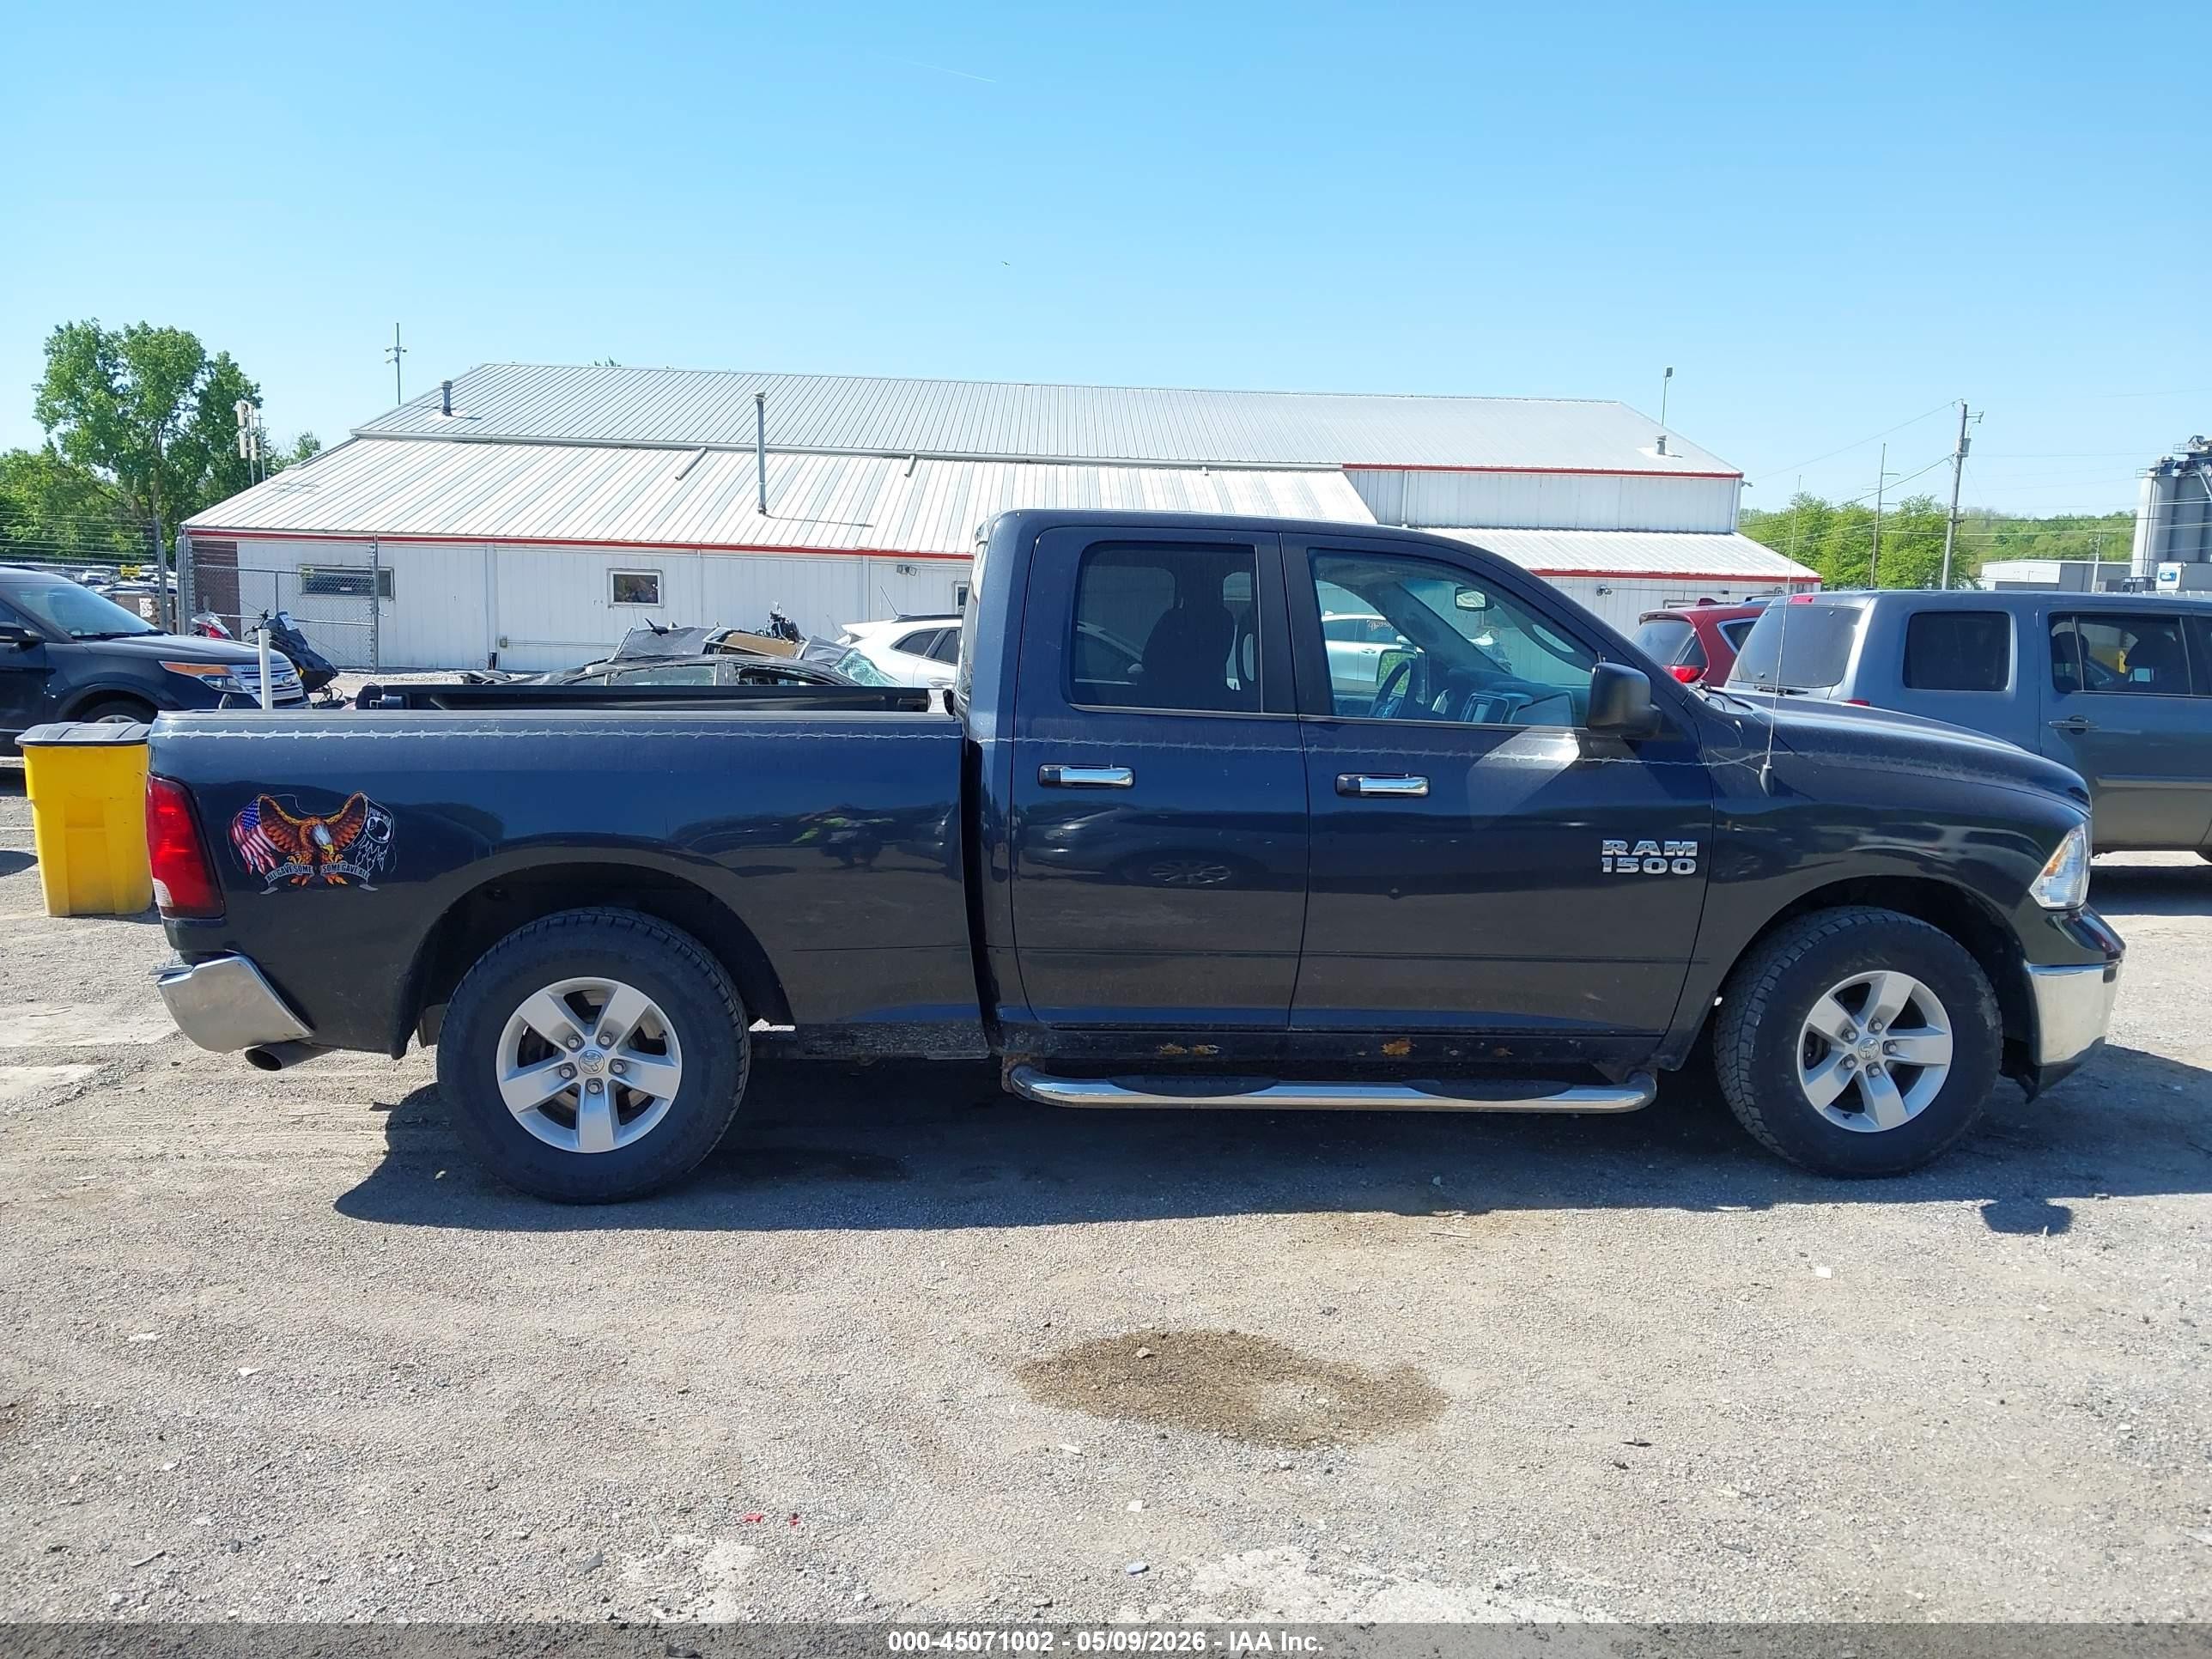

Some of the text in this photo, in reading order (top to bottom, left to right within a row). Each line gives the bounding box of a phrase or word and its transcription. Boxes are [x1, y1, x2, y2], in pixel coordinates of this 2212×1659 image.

[1601, 840, 1698, 856] RAM
[265, 864, 313, 882] ALL GAVE SOME
[322, 863, 369, 880] SOME GAVE ALL
[1601, 857, 1697, 875] 1500
